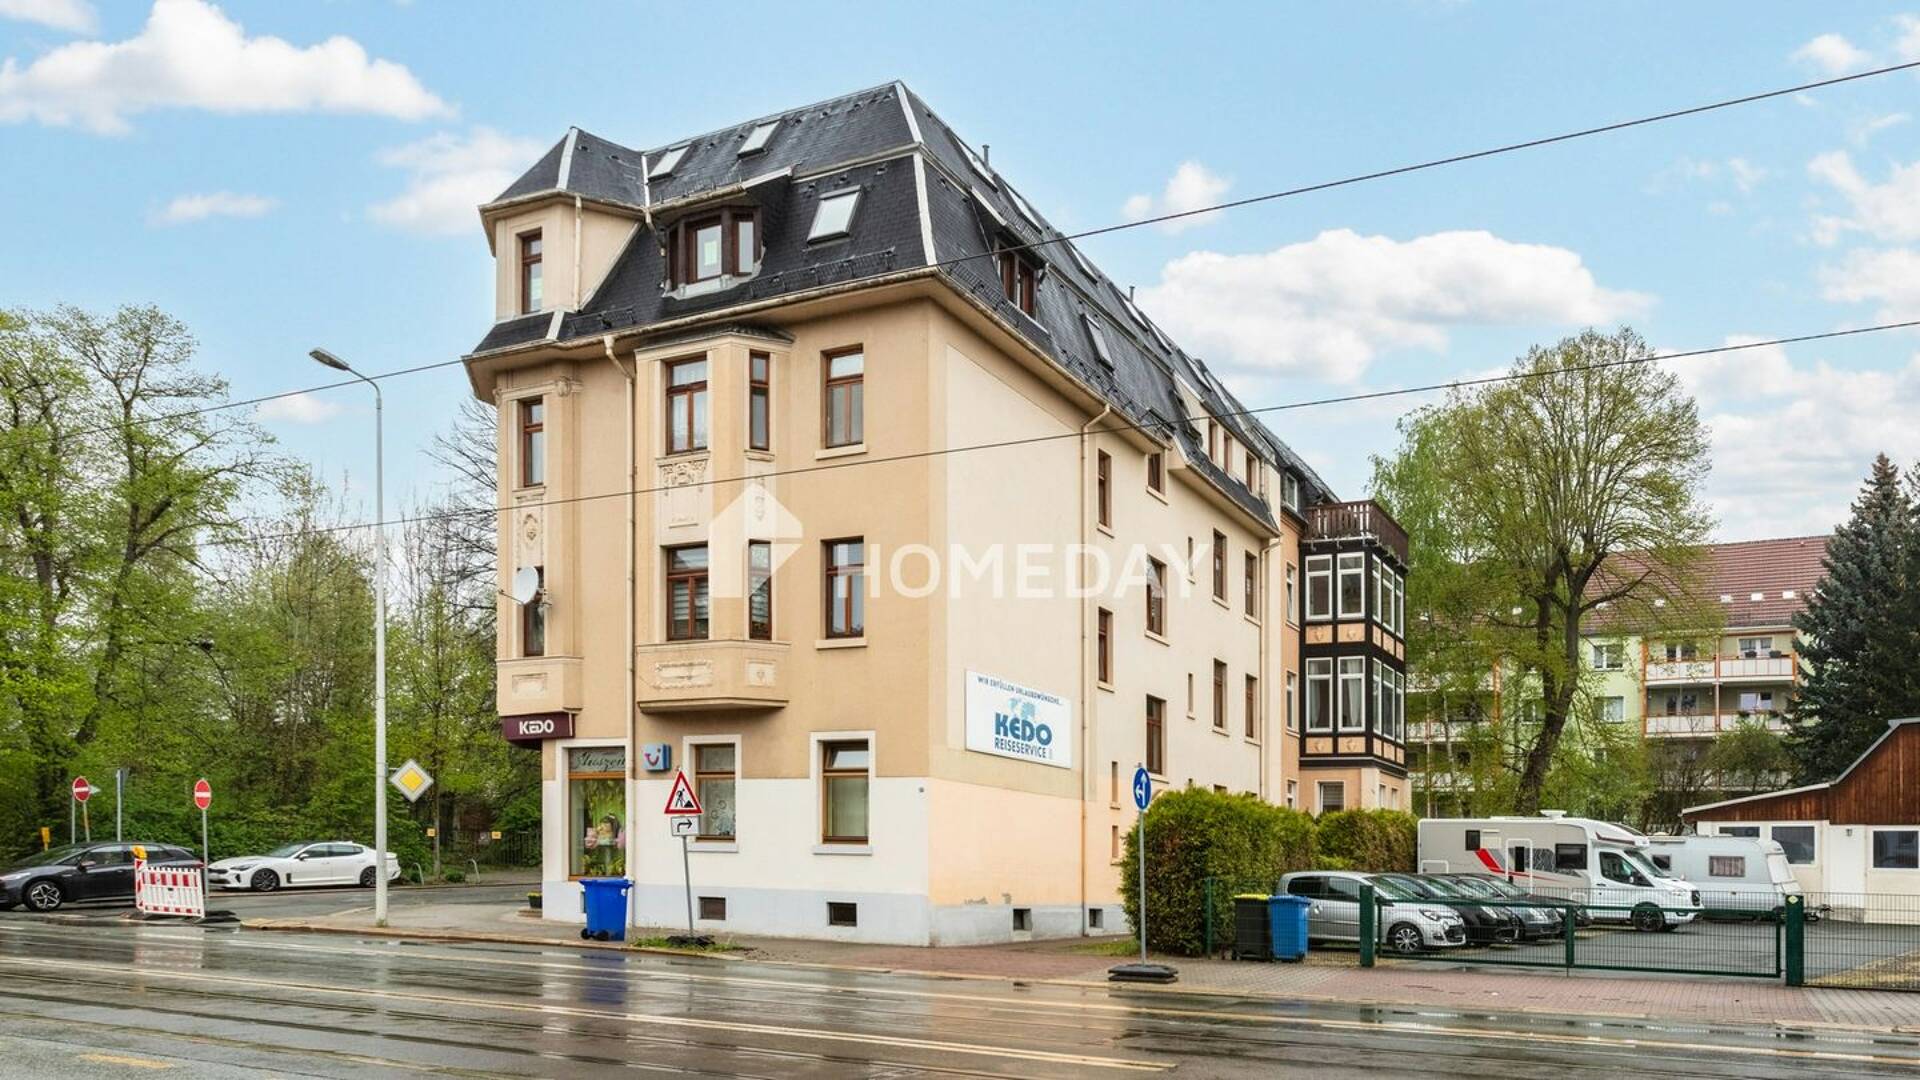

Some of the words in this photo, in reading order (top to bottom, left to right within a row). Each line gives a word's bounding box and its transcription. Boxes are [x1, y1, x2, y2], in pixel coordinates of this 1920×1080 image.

[519, 719, 555, 735] KEDO
[995, 712, 1052, 746] KEDO
[994, 737, 1047, 759] REISESERVICE
